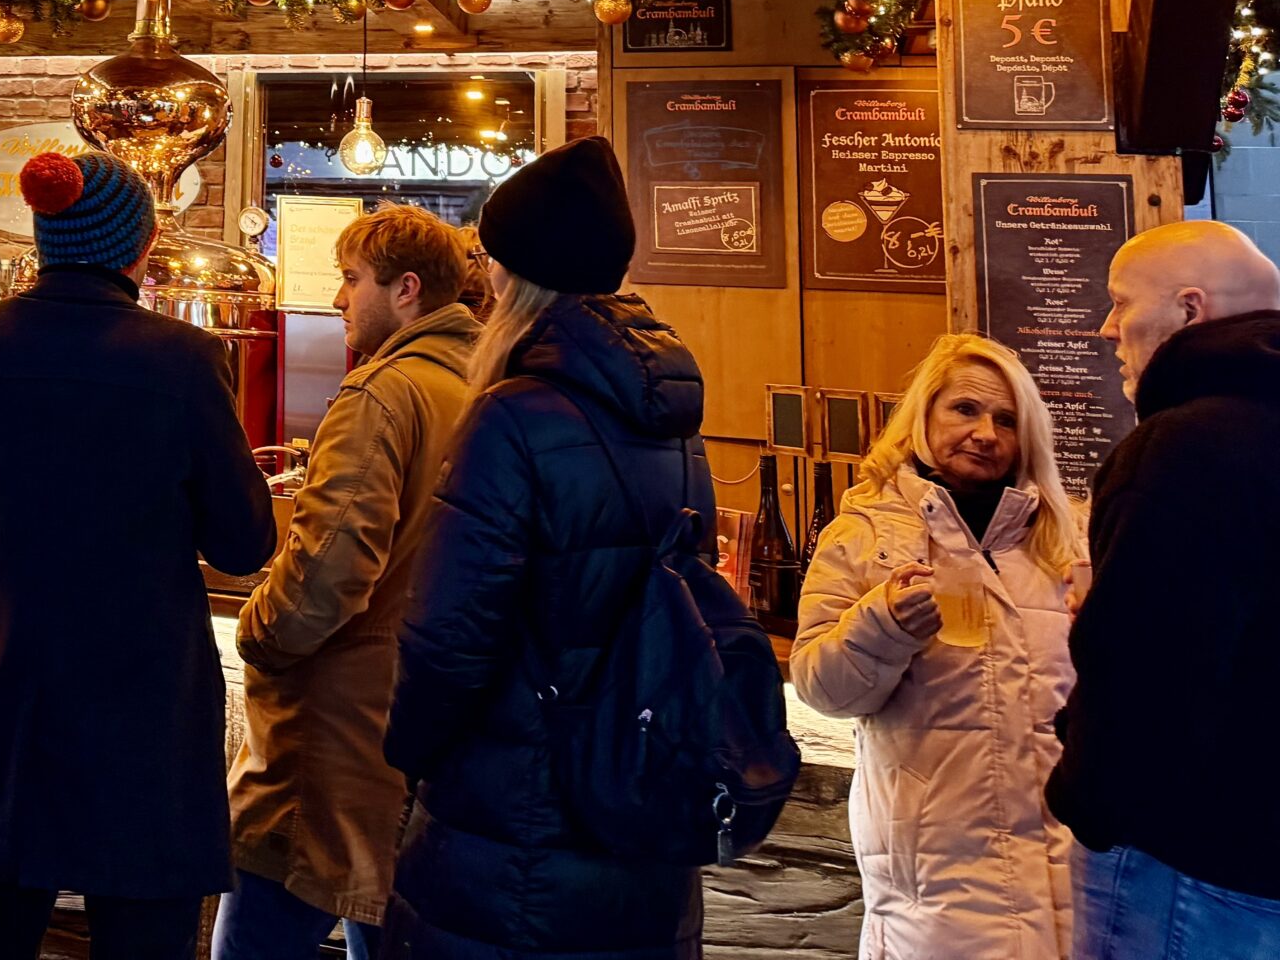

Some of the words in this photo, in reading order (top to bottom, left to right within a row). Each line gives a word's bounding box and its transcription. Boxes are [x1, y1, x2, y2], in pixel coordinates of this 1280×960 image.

[636, 6, 715, 19] Crambambuli
[1001, 15, 1022, 48] 5
[1031, 18, 1058, 45] €
[666, 99, 737, 111] Crambambuli
[835, 107, 926, 121] Crambambuli
[822, 131, 879, 149] Fescher
[832, 150, 879, 159] Heisser
[881, 150, 935, 162] Espresso
[859, 163, 908, 173] Martini
[662, 196, 701, 214] Amalfi
[703, 191, 740, 208] Spritz
[1007, 203, 1098, 217] Crambambuli
[995, 220, 1027, 229] Unsere
[1029, 221, 1112, 231] Getränkeauswahl
[1067, 341, 1089, 350] Apfel
[1065, 365, 1088, 374] Beere
[1065, 402, 1088, 411] Apfel
[1064, 427, 1087, 436] Apfel
